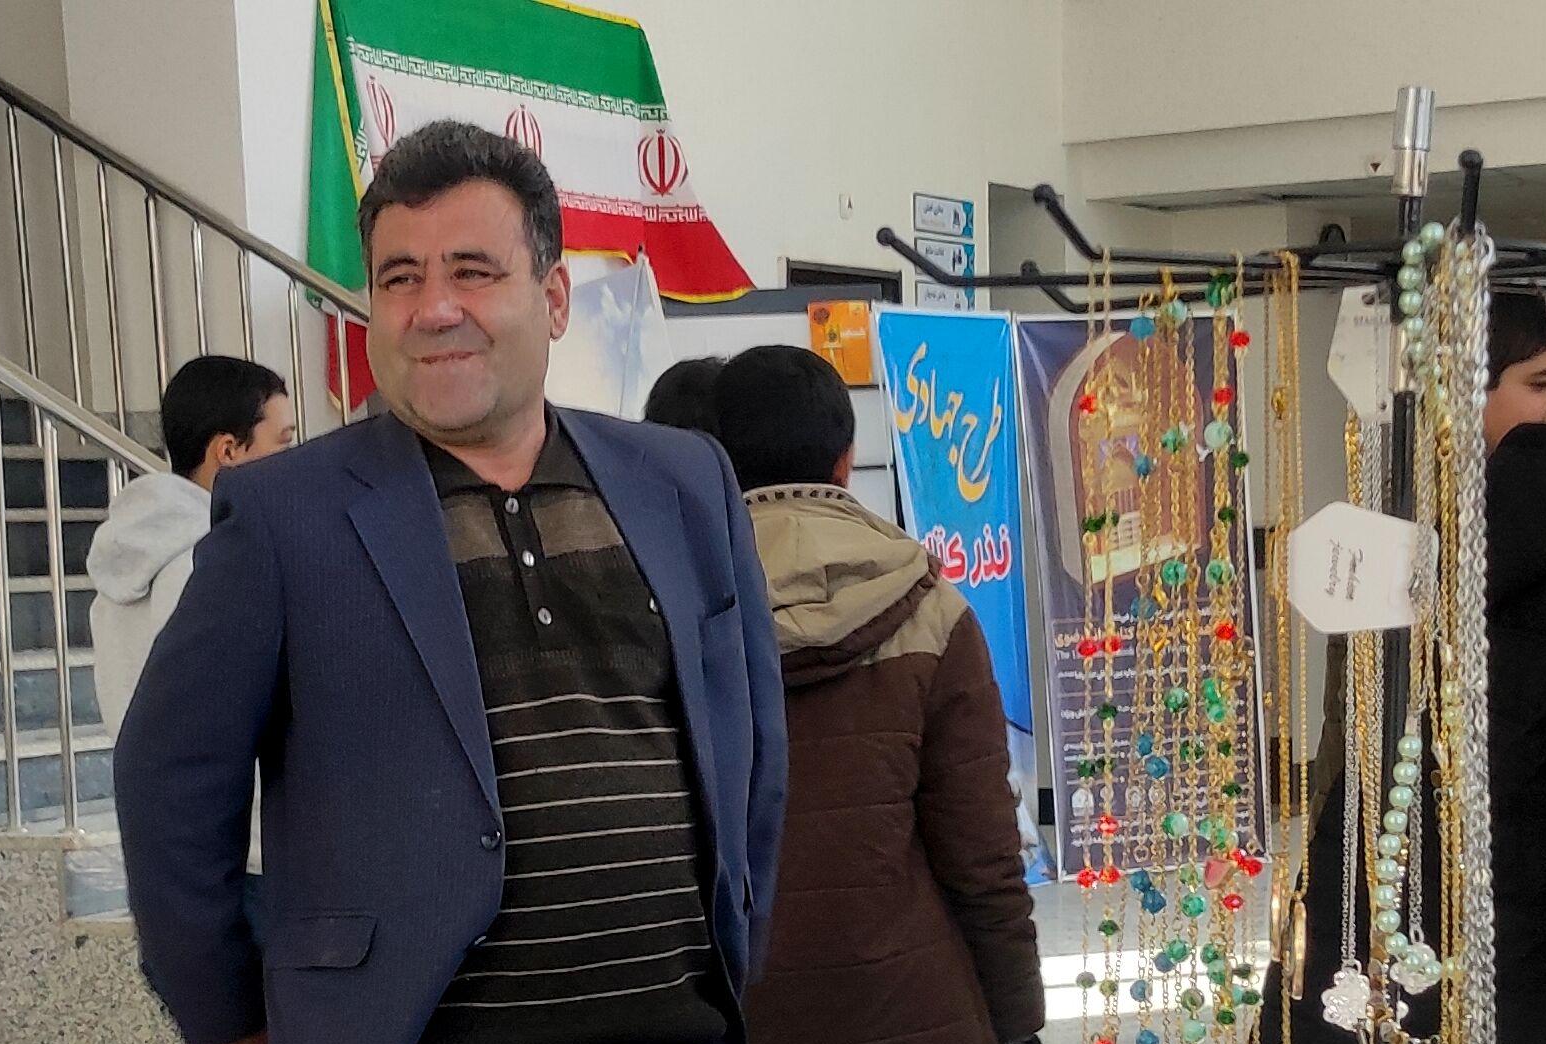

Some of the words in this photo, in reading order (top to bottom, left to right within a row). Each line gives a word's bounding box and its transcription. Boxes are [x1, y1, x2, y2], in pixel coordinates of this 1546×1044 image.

[892, 341, 964, 465] جهادی
[957, 376, 1002, 503] طرح
[924, 524, 968, 584] کتا
[968, 524, 1012, 588] نذر
